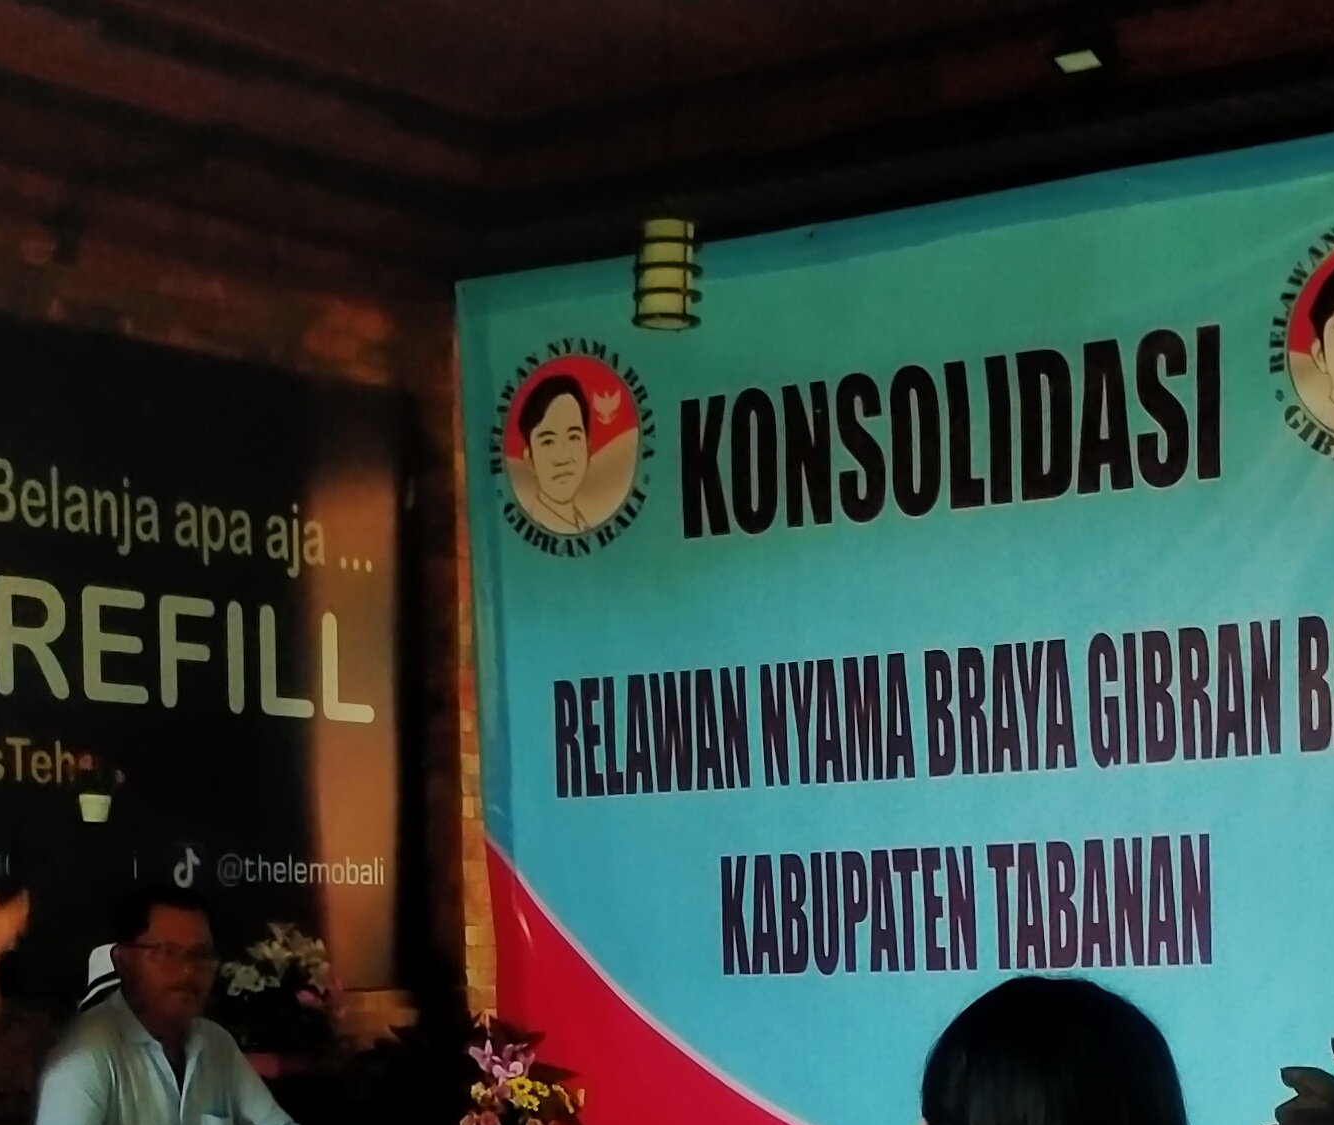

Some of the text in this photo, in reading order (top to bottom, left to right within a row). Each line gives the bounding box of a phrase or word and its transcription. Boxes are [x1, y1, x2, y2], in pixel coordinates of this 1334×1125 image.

[489, 337, 656, 475] RELAWAN NYAMA BRAYA
[681, 325, 1221, 540] KONSOLIDASI
[174, 501, 252, 566] apa
[266, 503, 325, 578] aja
[503, 488, 647, 557] GIBRAN BALI
[553, 666, 750, 798] RELAWAN
[759, 653, 916, 787] NYAMA
[925, 639, 1077, 776] BRAYA
[1088, 619, 1283, 770] GIBRAN
[217, 852, 385, 887] @thelemobali
[720, 834, 1212, 976] KABUPATEN TABANAN
